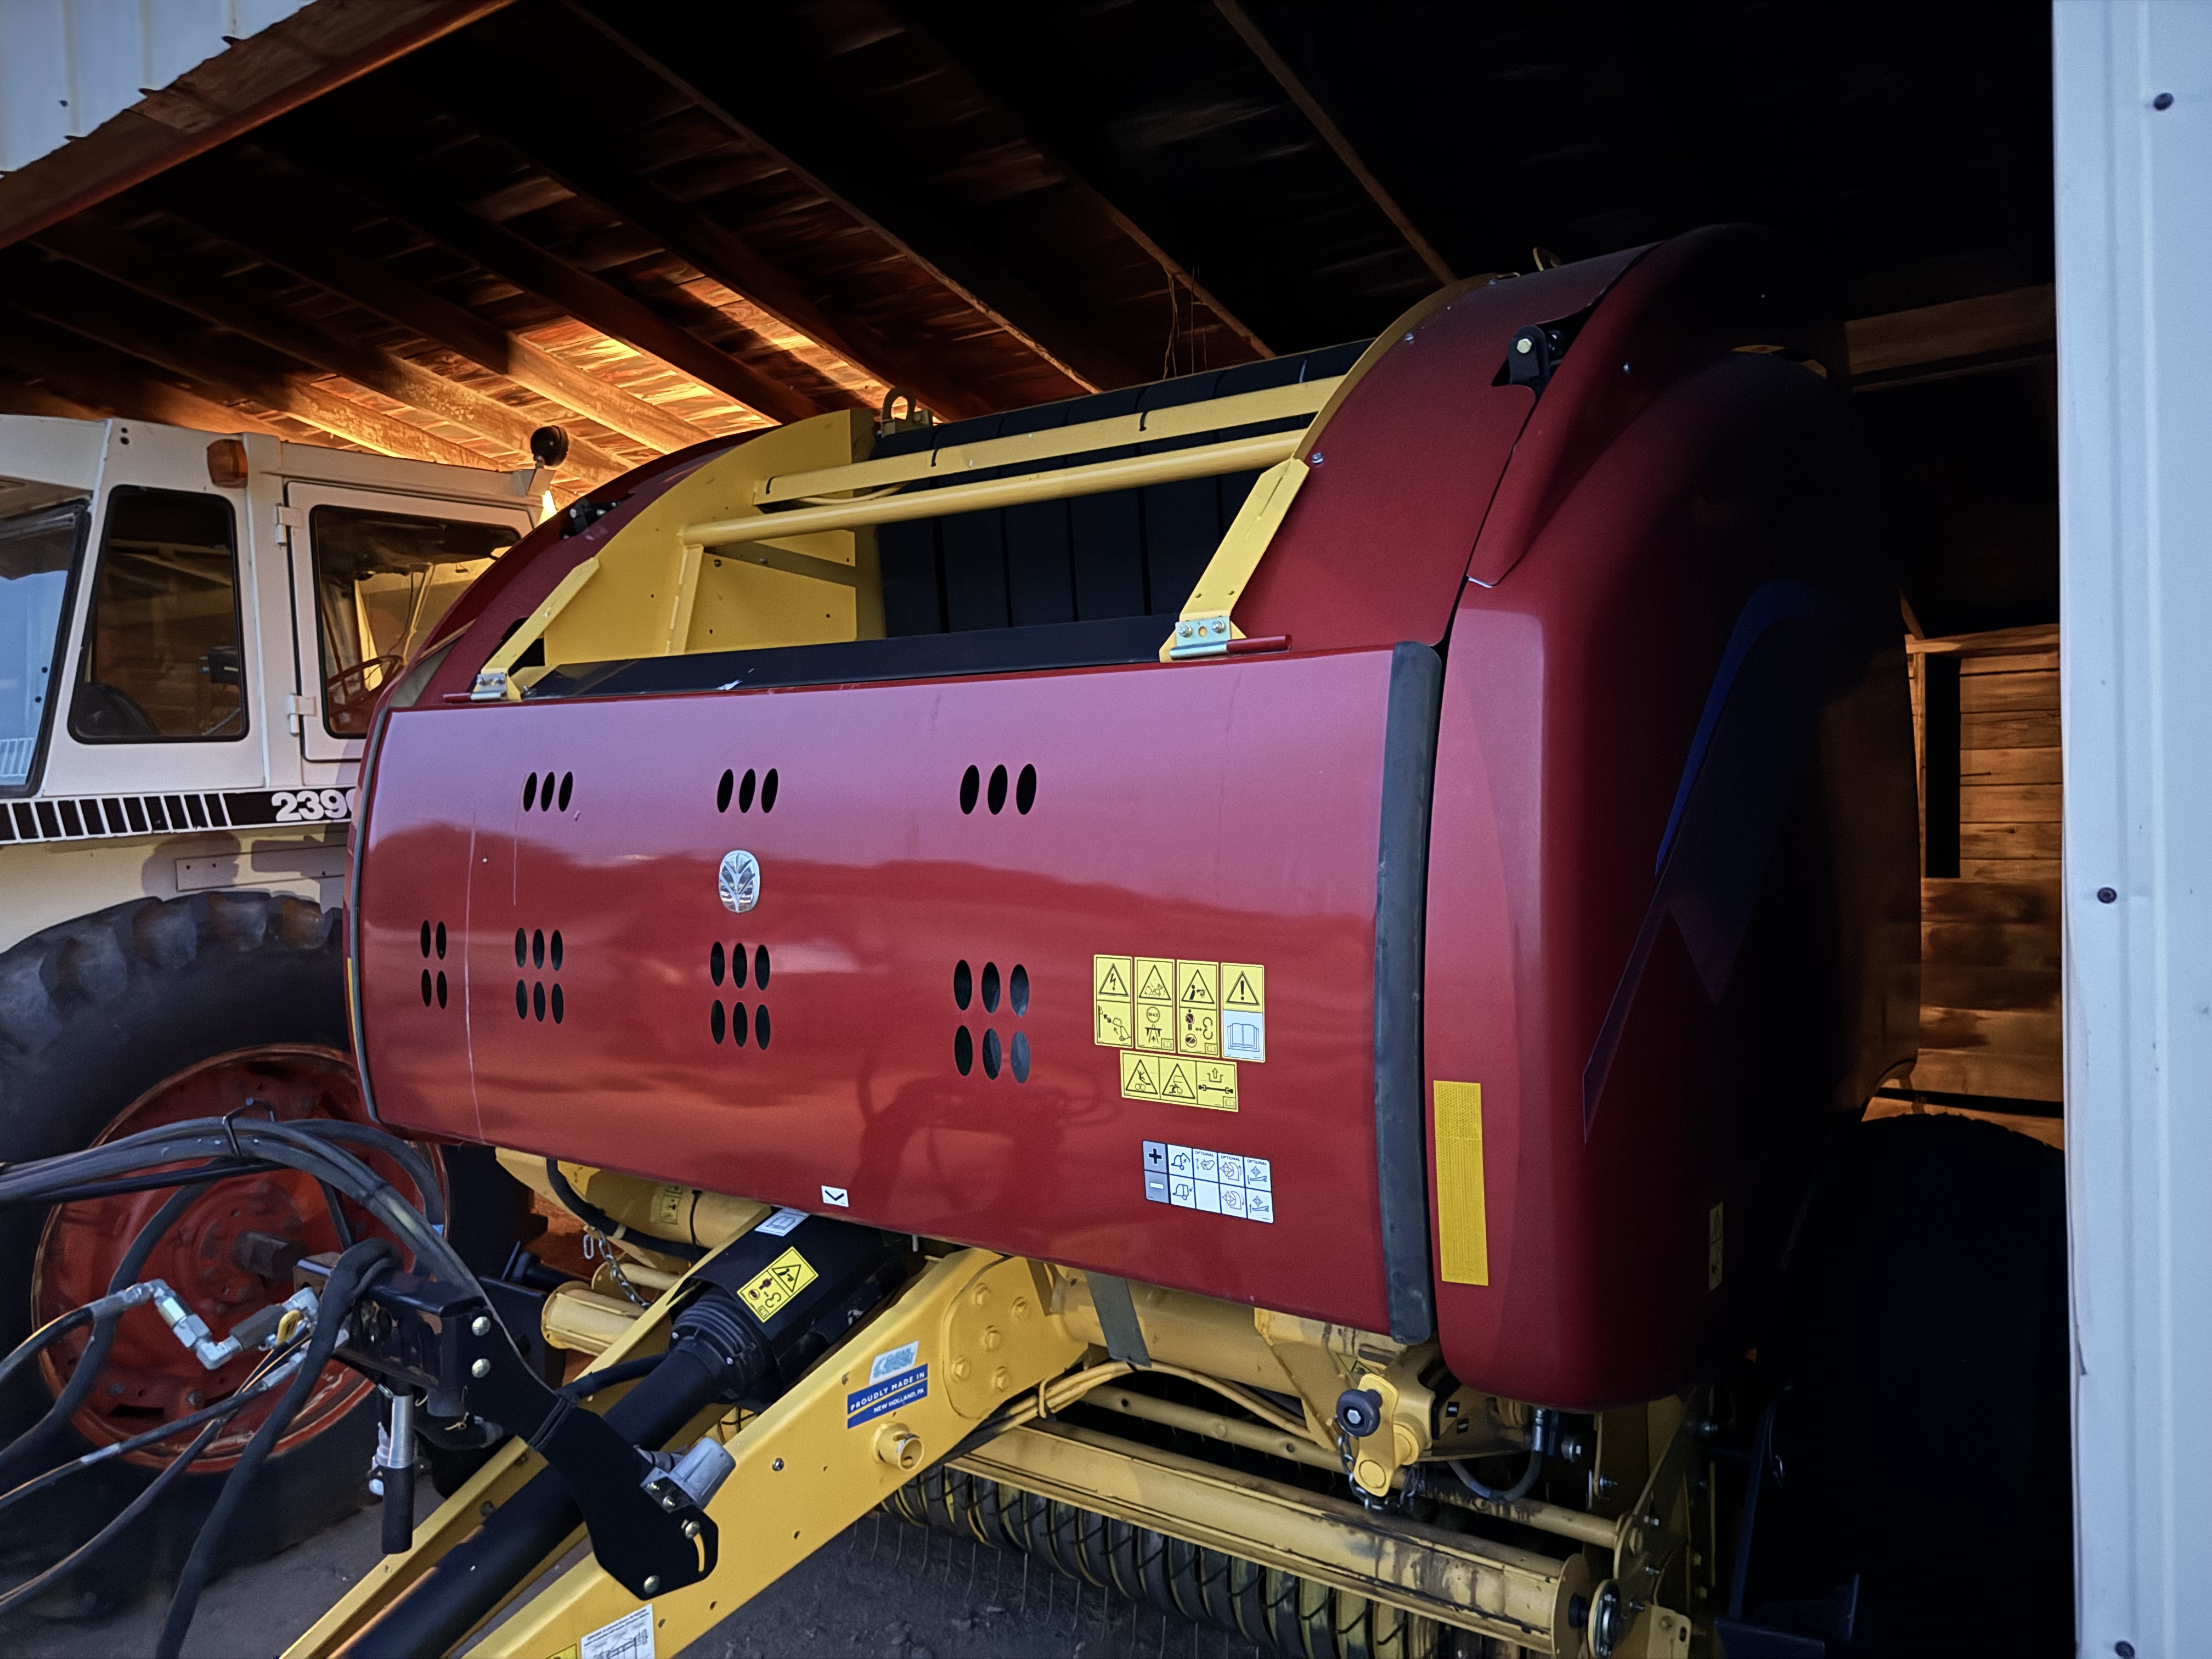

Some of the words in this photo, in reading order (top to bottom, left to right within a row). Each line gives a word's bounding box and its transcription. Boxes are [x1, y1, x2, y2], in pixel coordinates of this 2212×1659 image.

[850, 1387, 889, 1411] PROUDLY
[891, 1378, 913, 1391] MADE
[916, 1372, 925, 1380] IN
[873, 1403, 888, 1413] NEW
